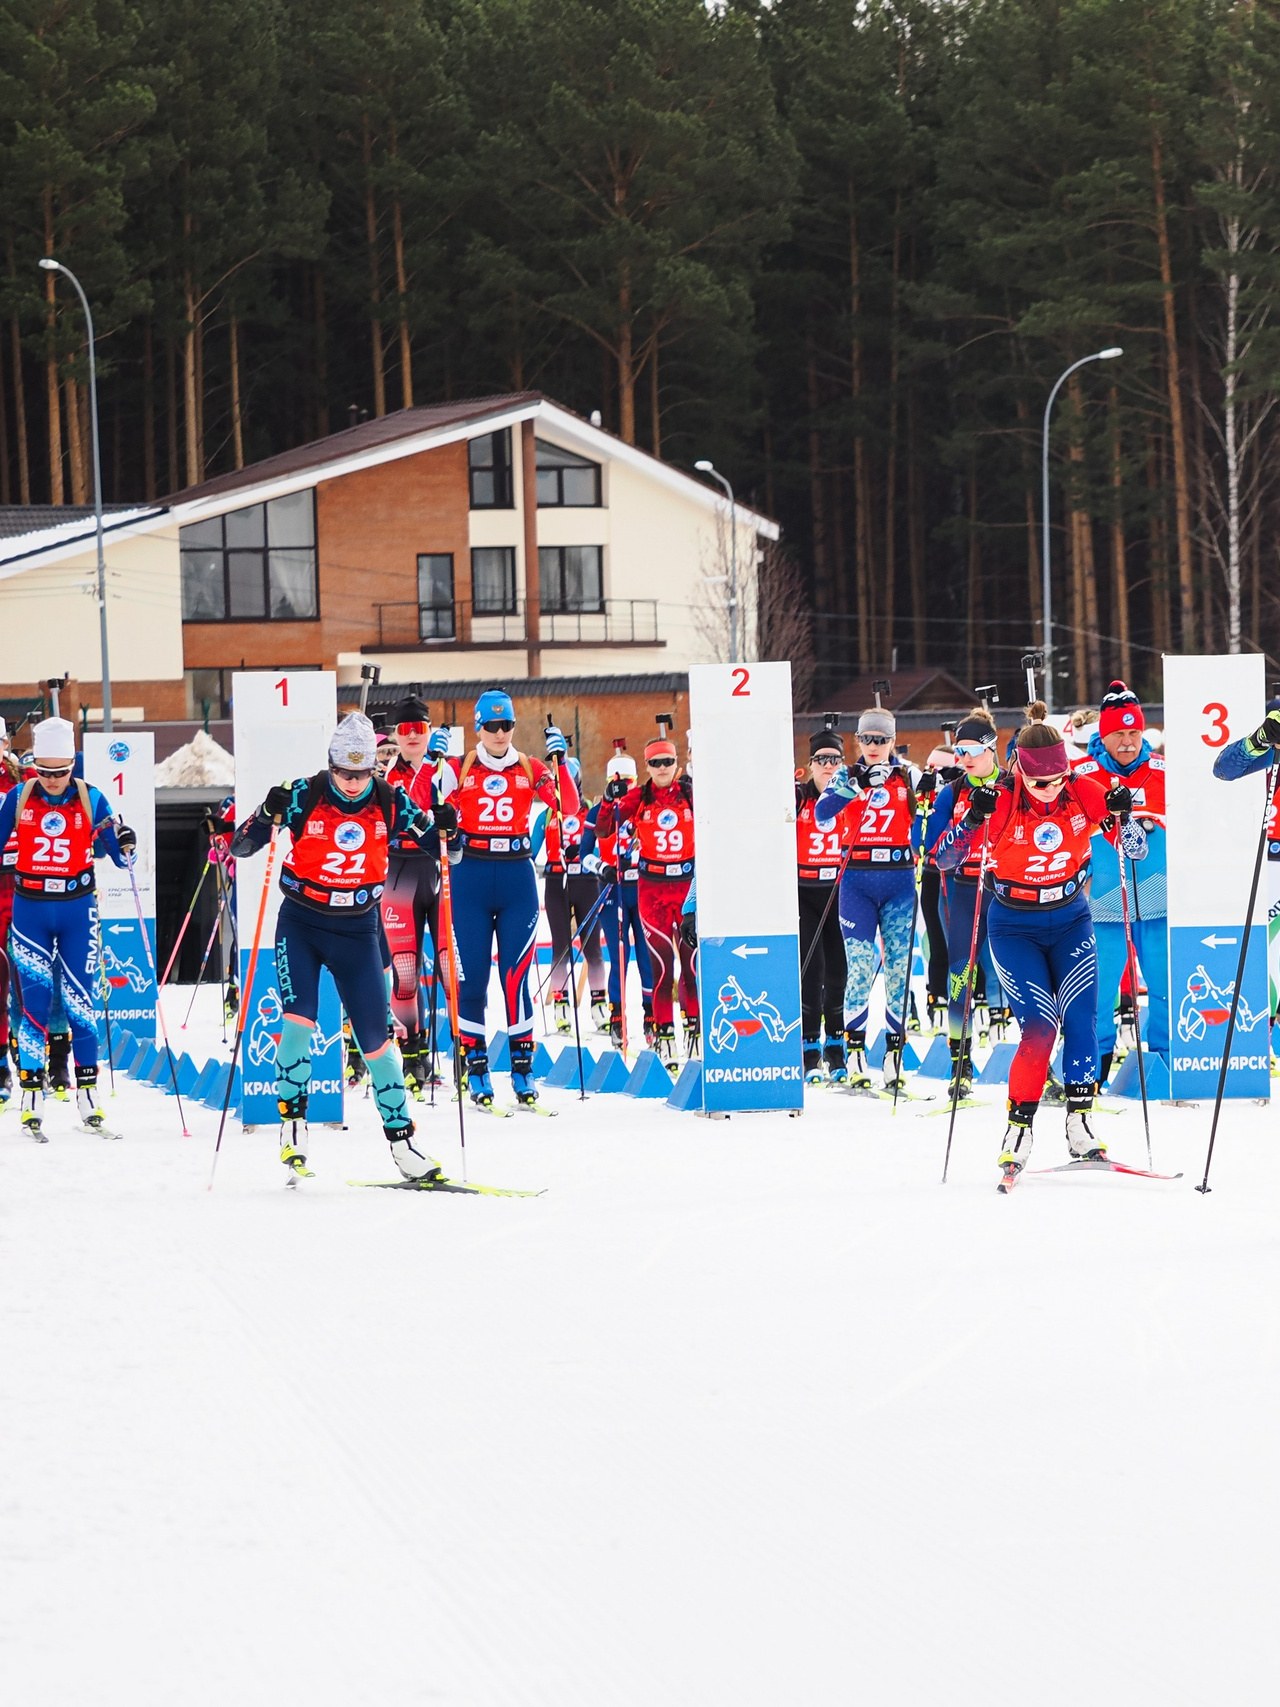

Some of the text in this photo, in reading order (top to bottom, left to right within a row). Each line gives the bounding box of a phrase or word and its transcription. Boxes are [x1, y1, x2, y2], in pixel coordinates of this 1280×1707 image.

[275, 678, 289, 706] 1
[731, 669, 751, 697] 2
[1063, 720, 1074, 737] 4
[1201, 702, 1231, 748] 3
[1079, 763, 1094, 774] 35
[113, 772, 125, 796] 1
[478, 797, 514, 822] 26
[860, 809, 896, 834] 27
[654, 830, 684, 852] 39
[809, 832, 841, 855] 31
[938, 821, 968, 855] MOA
[32, 837, 71, 863] 25
[32, 865, 69, 873] КРАСНОЯРСК
[322, 852, 367, 875] 21
[1024, 851, 1072, 873] 22
[319, 874, 362, 885] КРАСНОЯРСК
[1024, 872, 1066, 883] КРАСНОЯРСК
[85, 908, 99, 974] ЯМАЛ
[705, 1066, 801, 1083] КРАСНОЯРСК
[1173, 1055, 1268, 1072] КРАСНОЯРСК
[396, 1129, 408, 1138] 171
